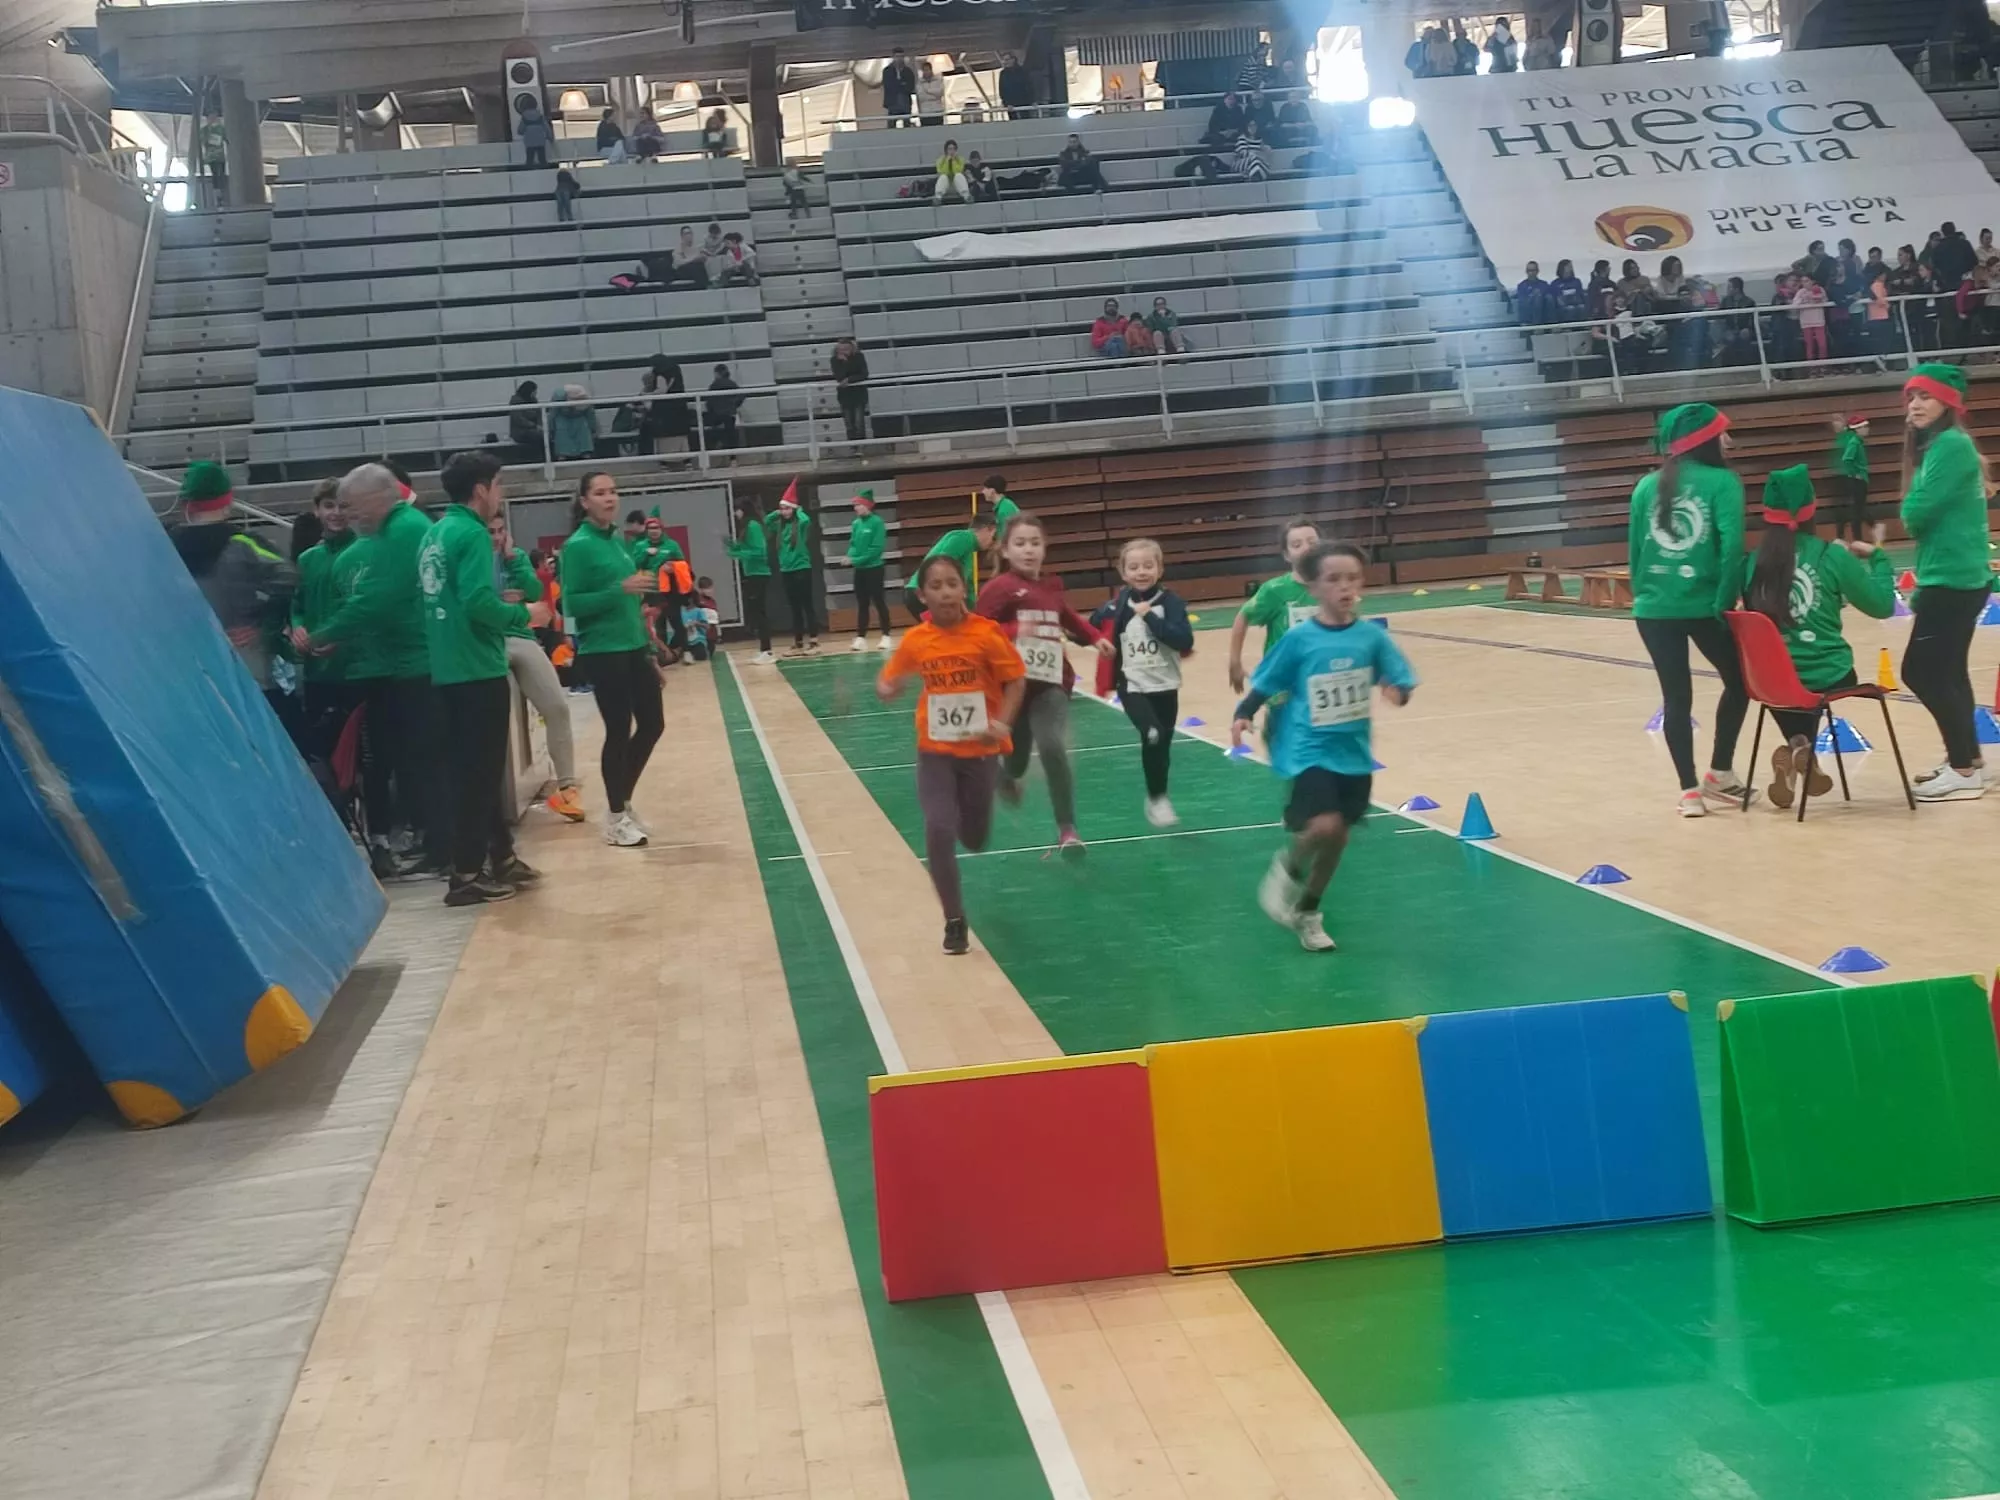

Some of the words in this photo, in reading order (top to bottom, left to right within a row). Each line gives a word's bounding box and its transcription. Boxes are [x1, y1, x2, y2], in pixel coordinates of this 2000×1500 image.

[1478, 100, 1896, 158] Huesca
[1708, 196, 1898, 221] DIPUTACIÓN
[1715, 210, 1905, 235] HUESCA
[1025, 647, 1056, 669] 392
[1127, 639, 1159, 658] 340
[937, 706, 976, 727] 367
